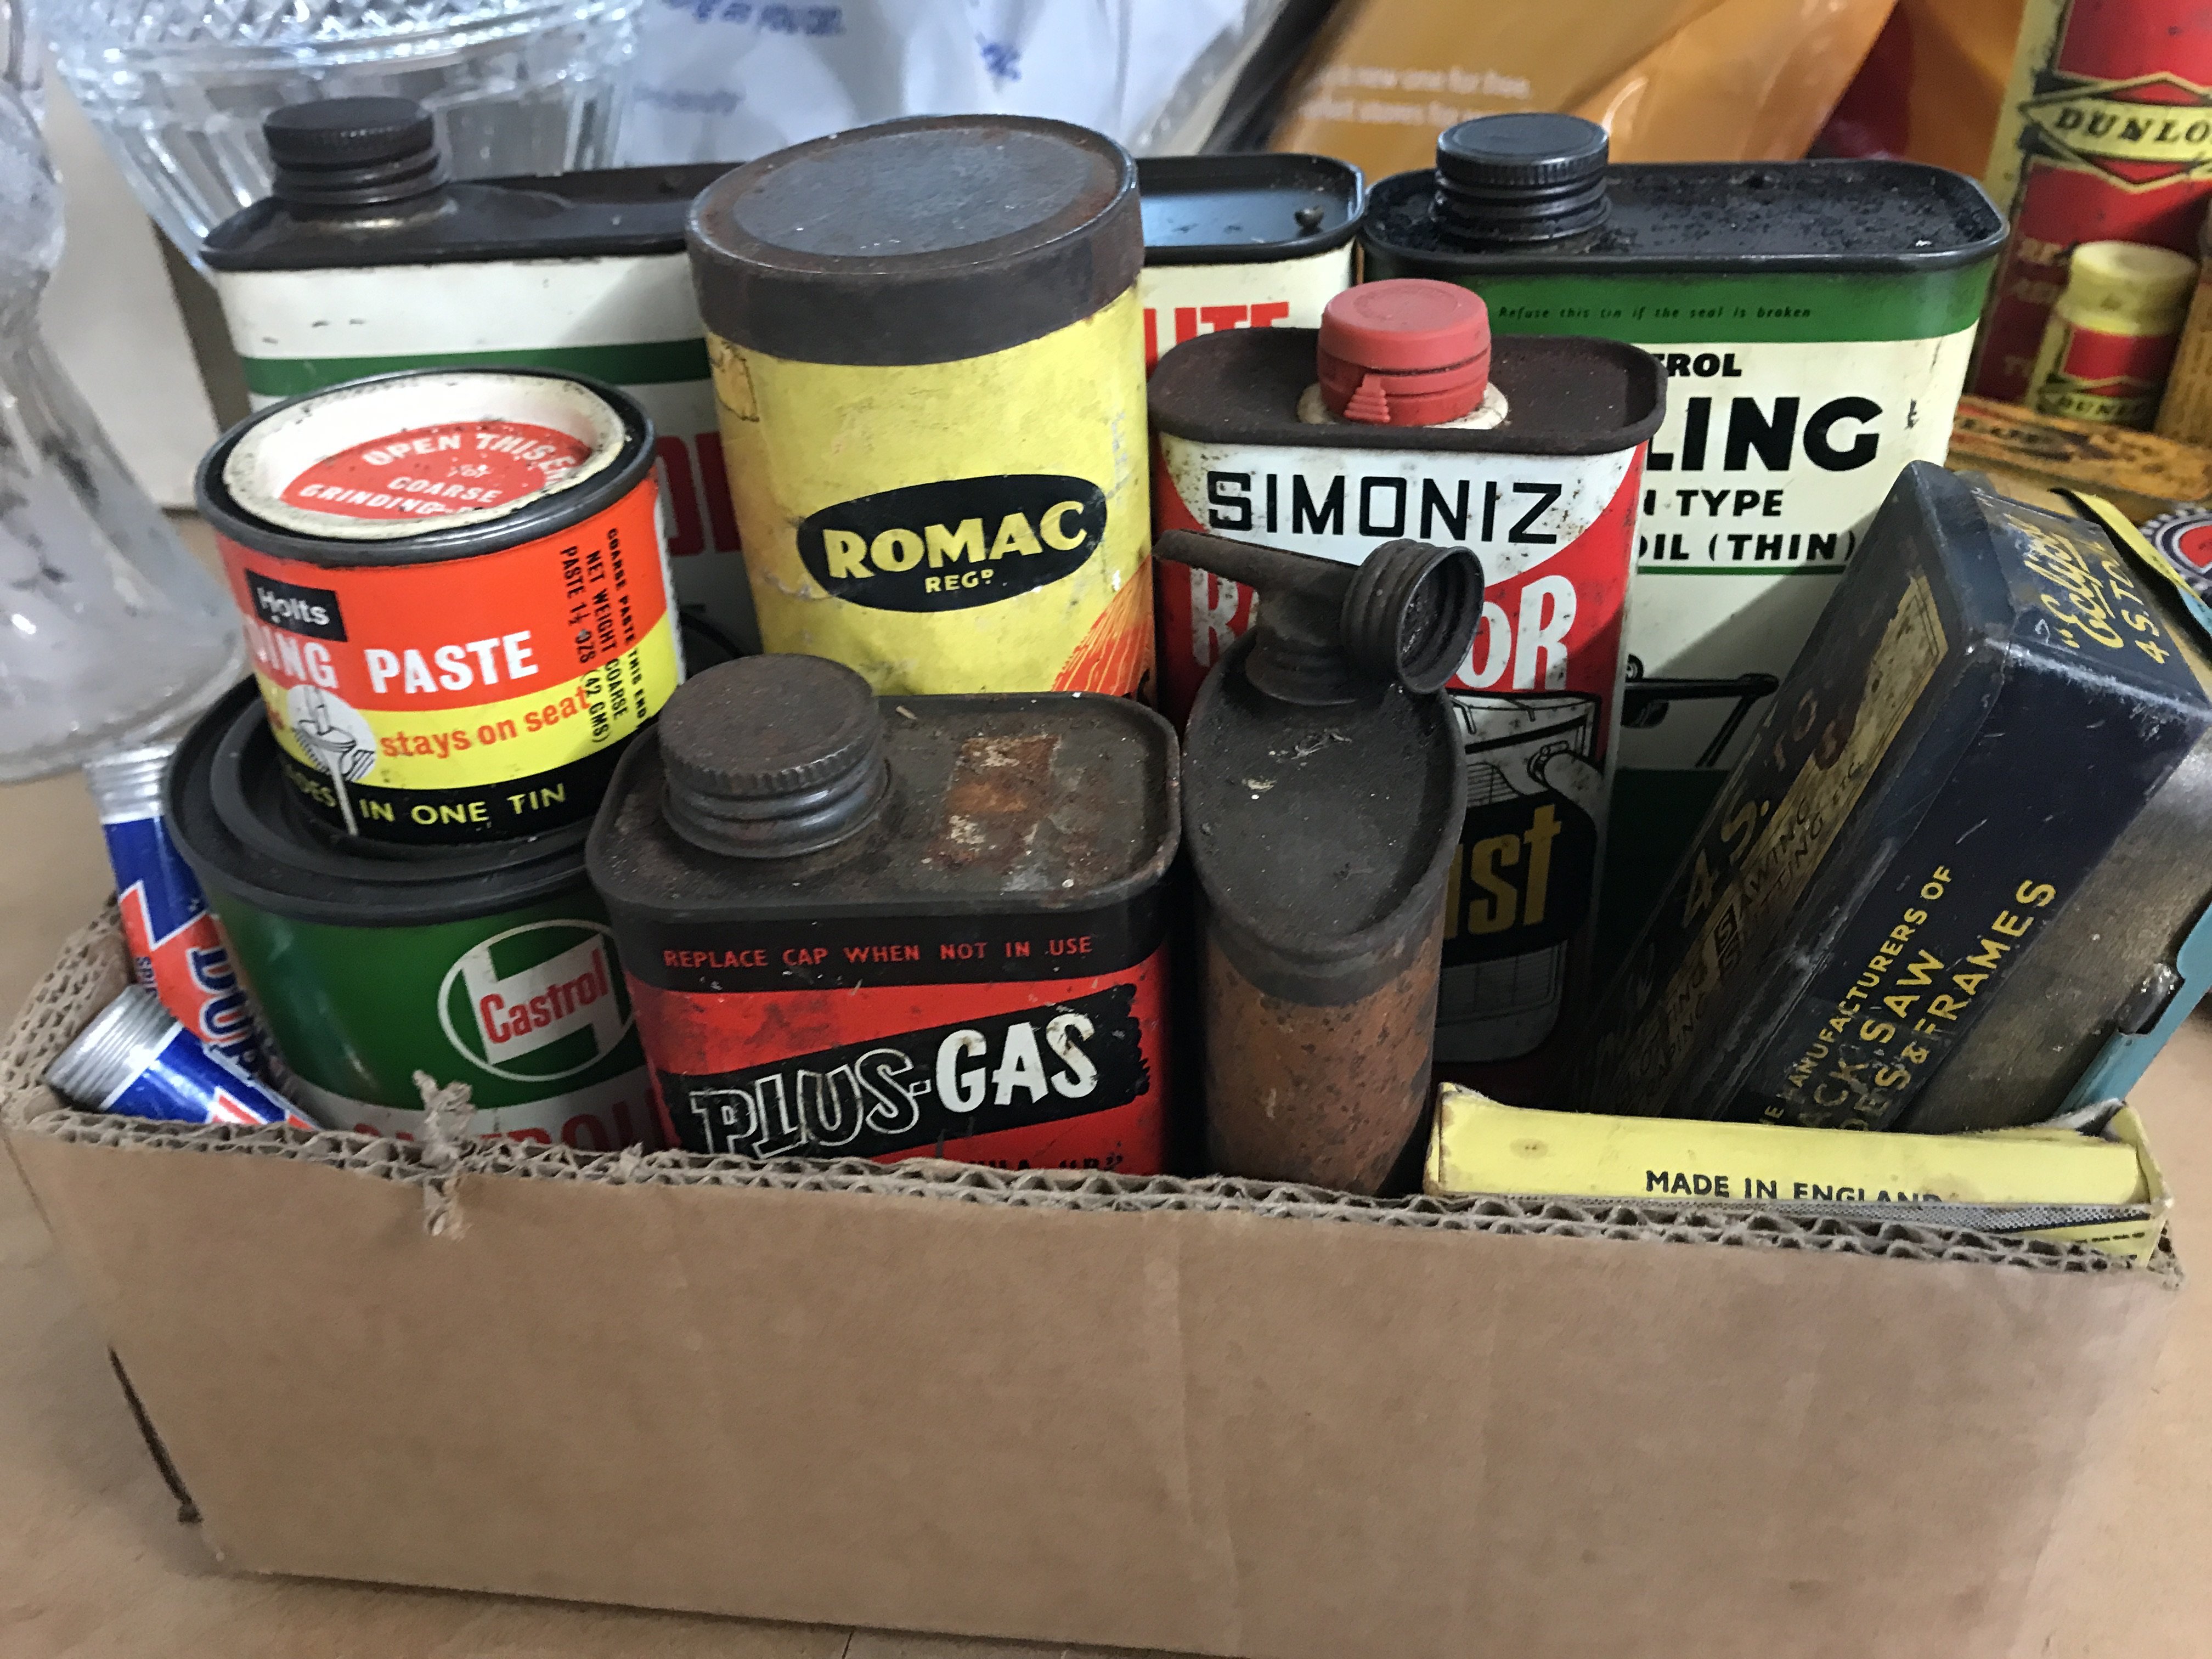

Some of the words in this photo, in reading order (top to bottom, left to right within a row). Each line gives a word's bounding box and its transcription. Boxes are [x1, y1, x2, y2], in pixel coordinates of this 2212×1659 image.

[1498, 306, 1550, 320] Refuse
[1559, 307, 1590, 319] this
[1600, 307, 1622, 319] tin
[1632, 306, 1645, 320] if
[1655, 306, 1679, 319] the
[1690, 306, 1723, 319] seal
[1734, 307, 1746, 319] is
[1757, 306, 1811, 319] broken
[1656, 353, 1742, 377] ROL
[361, 434, 461, 466] OPEN
[475, 432, 556, 462] THIS
[387, 476, 503, 504] COARSE
[1207, 471, 1562, 544] SIMONIZ
[1676, 489, 1784, 517] TYPE
[607, 528, 627, 591] COARSE
[822, 500, 1088, 579] ROMAC
[1707, 532, 1857, 562] (THIN)
[586, 550, 606, 583] NET
[257, 587, 330, 625] Holts
[592, 587, 617, 653] WEIGHT
[619, 594, 636, 646] PASTE
[365, 630, 540, 695] PASTE
[560, 545, 585, 599] PASTE
[589, 701, 612, 743] GMS)
[627, 647, 643, 685] THIS
[604, 658, 629, 721] COARSE
[633, 689, 648, 719] END
[380, 730, 472, 759] stays
[477, 719, 518, 746] on
[523, 685, 591, 732] seat
[359, 798, 396, 823] IN
[411, 801, 489, 825] ONE
[506, 783, 567, 816] TIN
[1716, 797, 1810, 939] SAWING
[1921, 865, 1953, 901] OF
[663, 949, 769, 969] REPLACE
[782, 947, 829, 967] CAP
[843, 944, 921, 964] WHEN
[940, 942, 988, 961] NOT
[1005, 940, 1031, 958] IN
[1049, 936, 1093, 957] USE
[1913, 879, 2057, 1036] FRAMES
[479, 948, 610, 1043] Castrol
[1860, 950, 1945, 1044] SAW
[1902, 1042, 1928, 1065] &
[1646, 1170, 1730, 1198] MADE
[1745, 1178, 1778, 1199] IN
